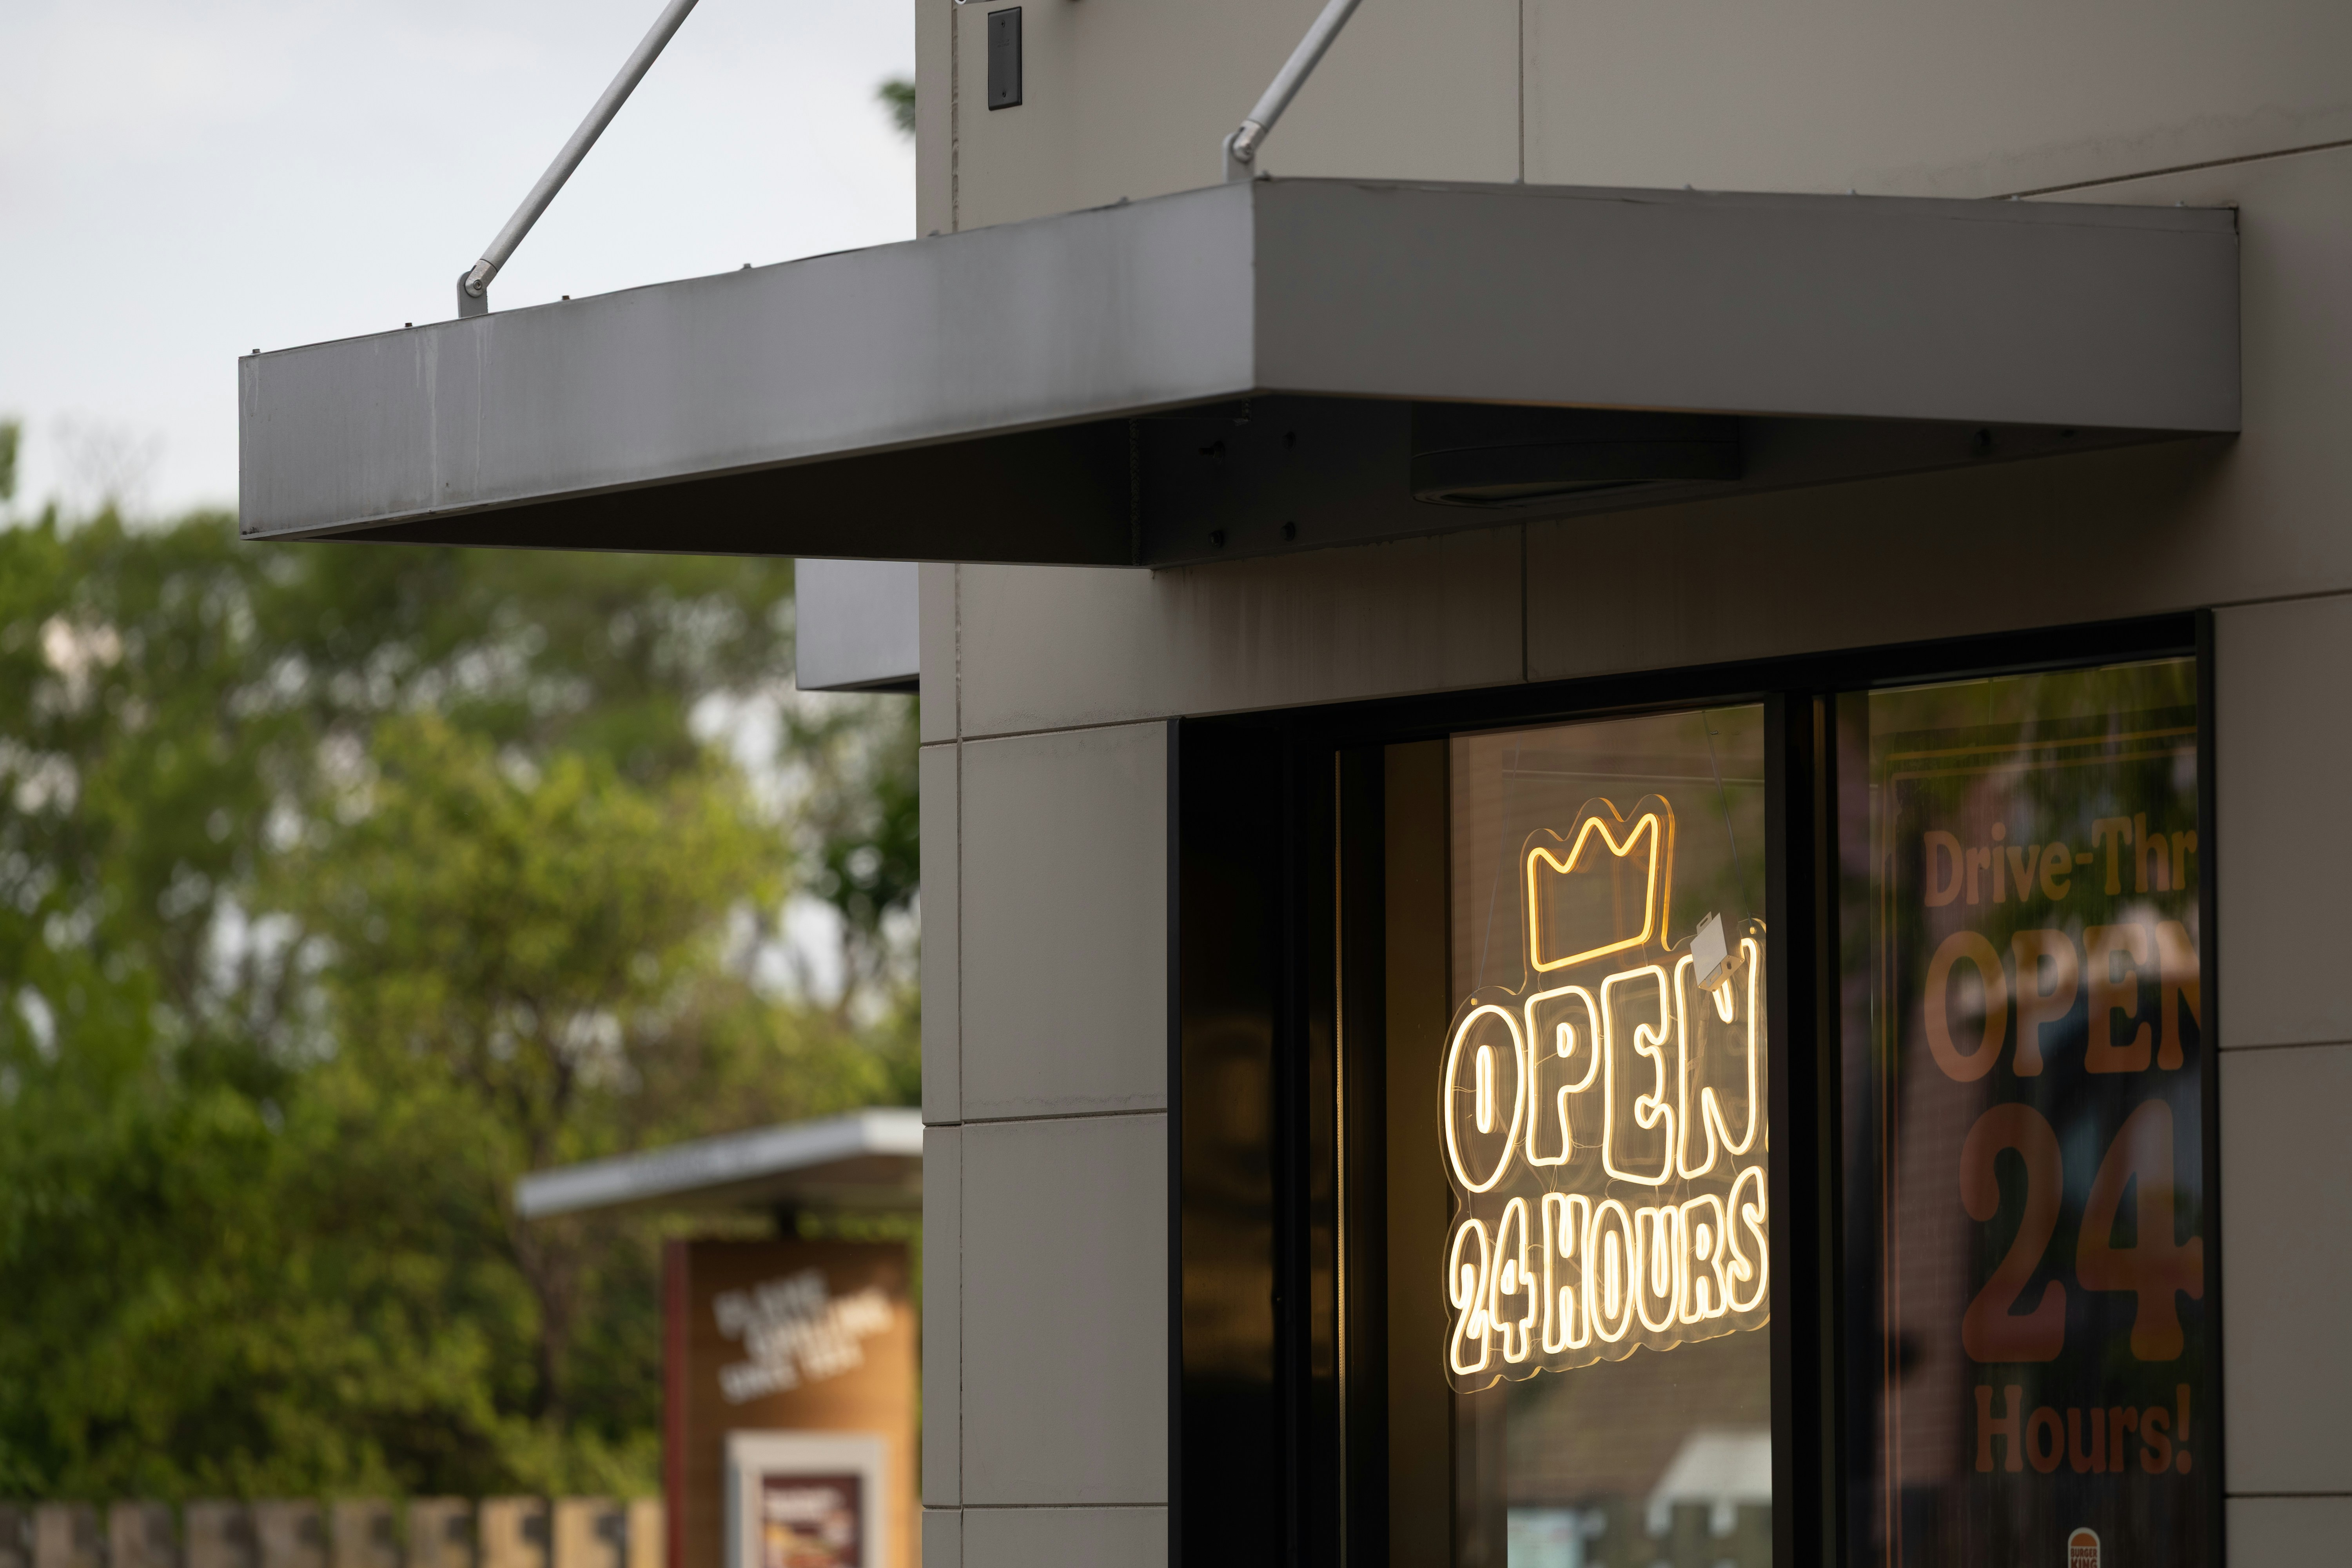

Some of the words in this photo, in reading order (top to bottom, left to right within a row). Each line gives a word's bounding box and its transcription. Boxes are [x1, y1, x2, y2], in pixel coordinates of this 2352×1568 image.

[1444, 937, 1758, 1193] OPEN
[1449, 1197, 1536, 1375] 24
[1542, 1165, 1768, 1354] HOURS
[1960, 1099, 2203, 1363] 24
[1974, 1383, 2192, 1475] Hours!
[2071, 1548, 2097, 1557] BURGER
[2071, 1558, 2097, 1568] KING
